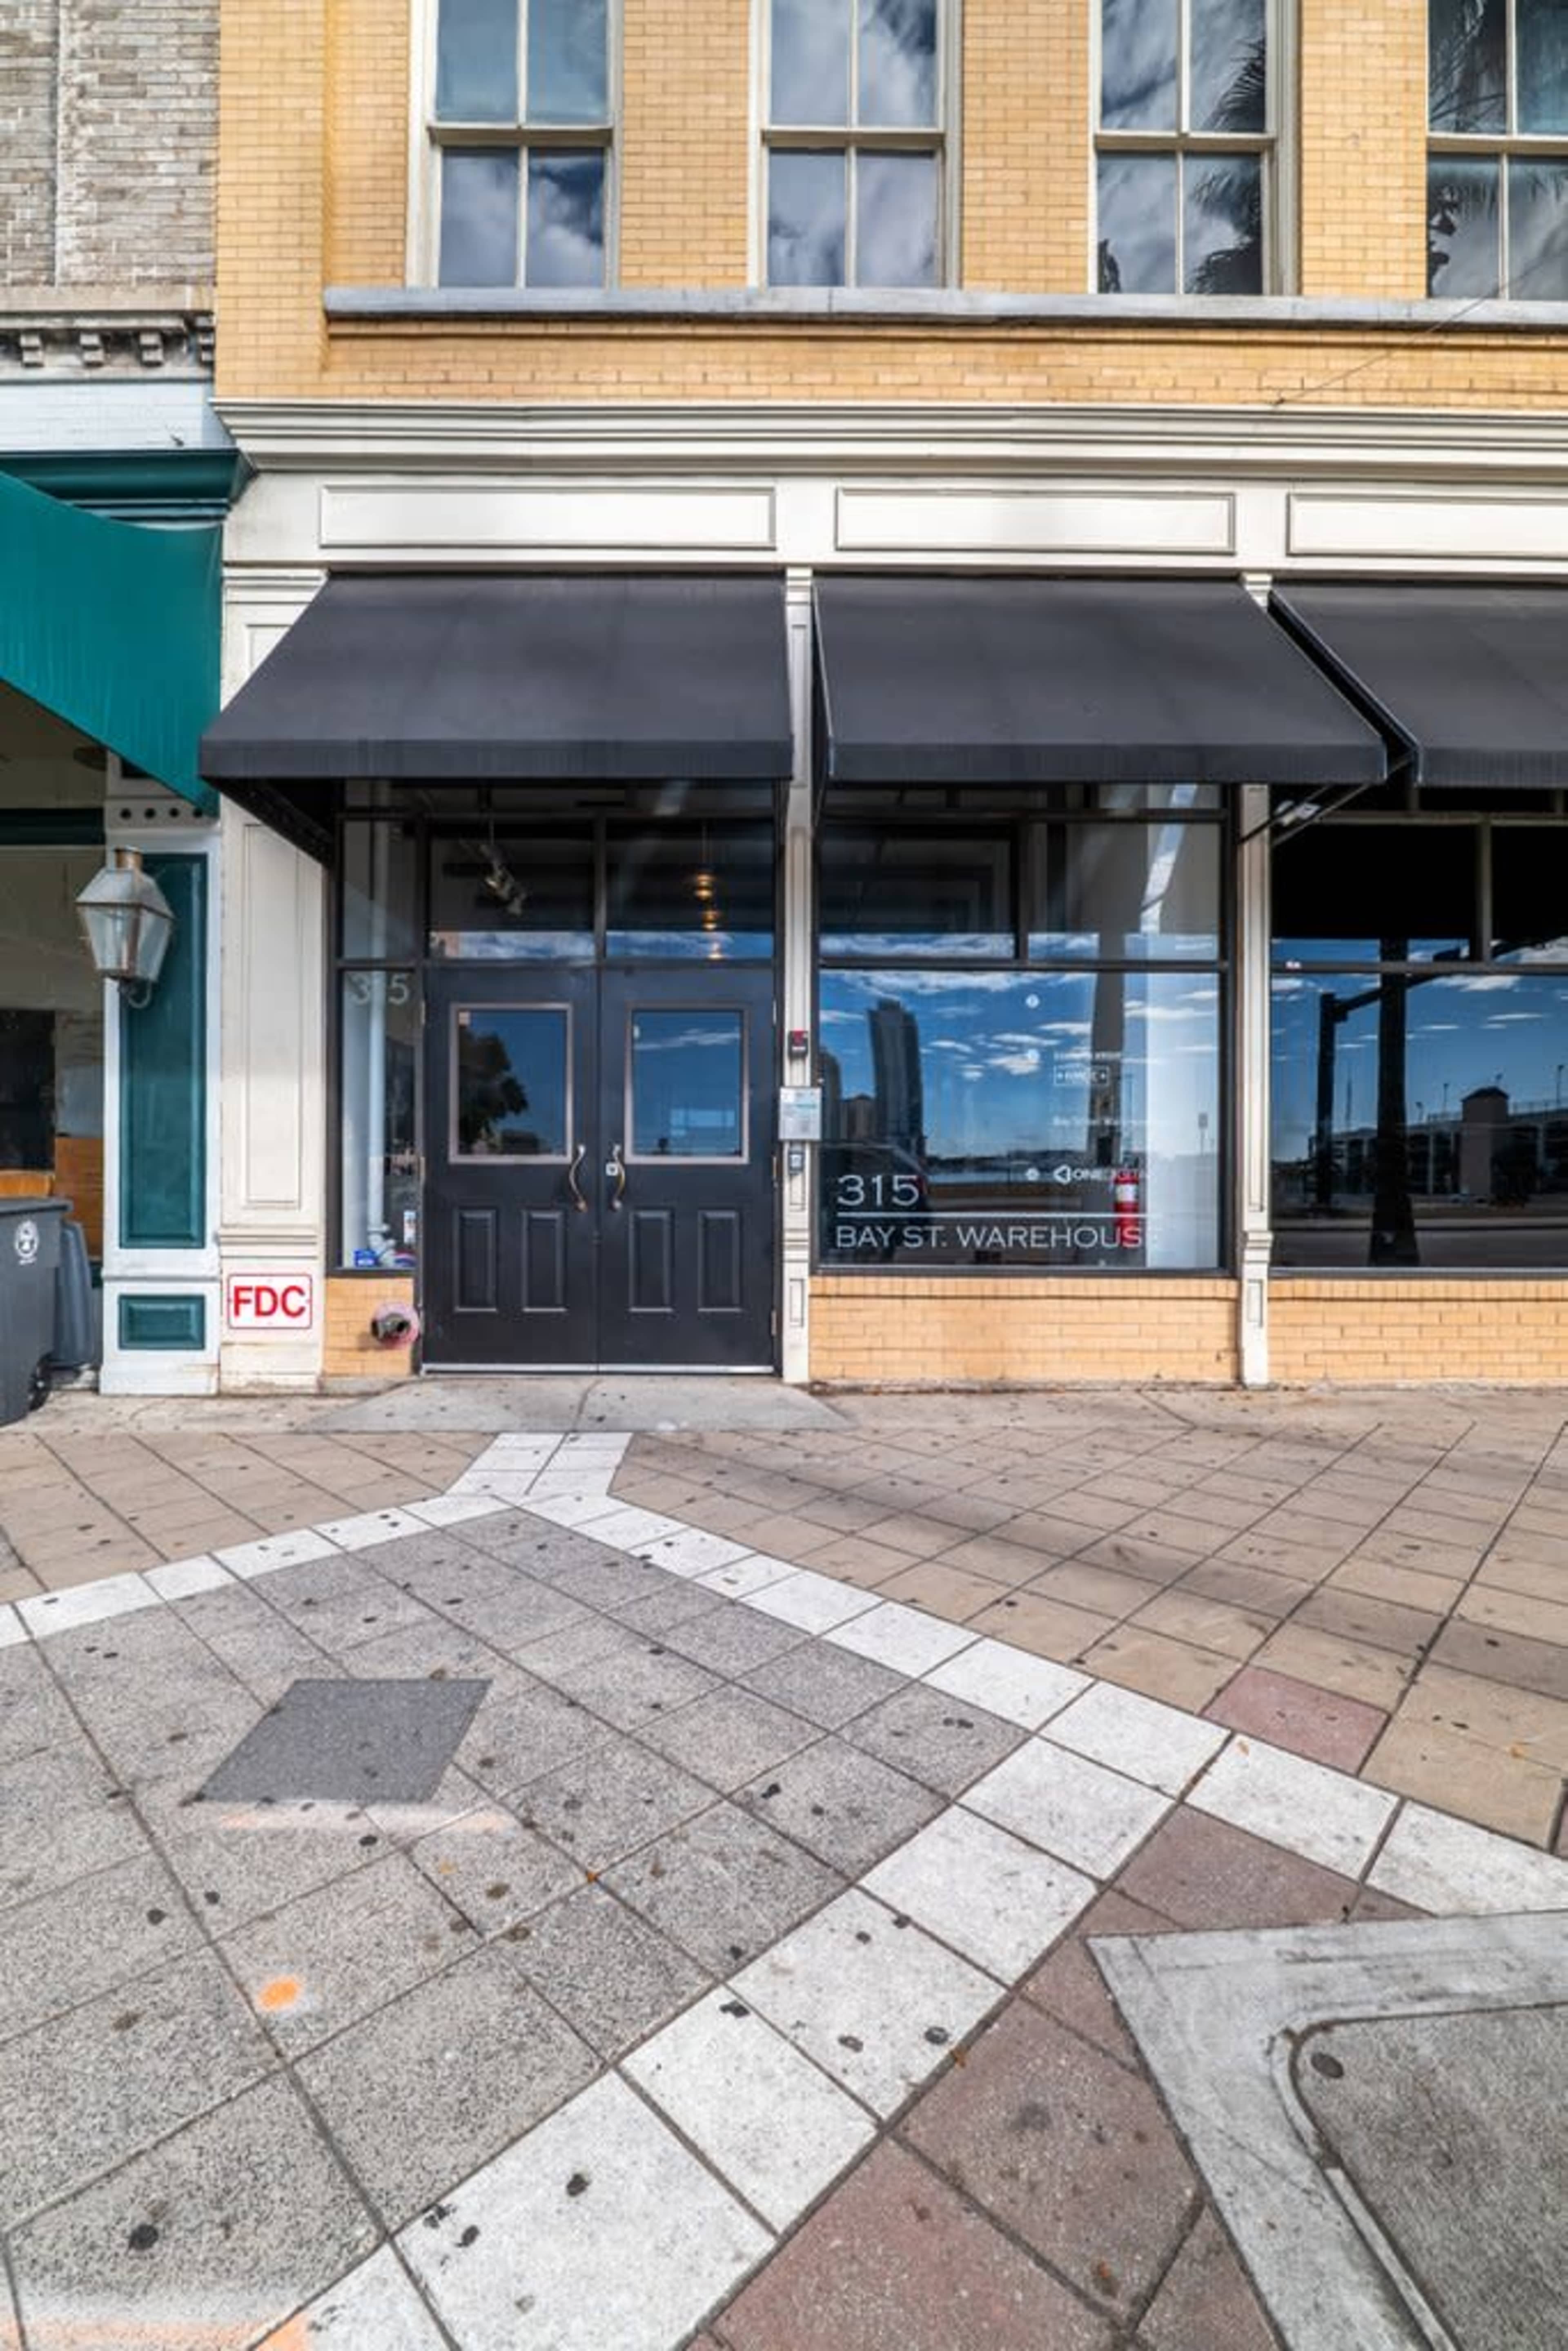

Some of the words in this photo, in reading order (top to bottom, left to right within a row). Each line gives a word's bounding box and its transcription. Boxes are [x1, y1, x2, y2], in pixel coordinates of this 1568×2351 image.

[350, 974, 410, 1005] 35
[837, 1174, 920, 1206] 315
[836, 1226, 895, 1248] BAY
[903, 1226, 947, 1248] ST.
[956, 1226, 1143, 1248] WAREHOUS
[234, 1285, 305, 1318] FDC
